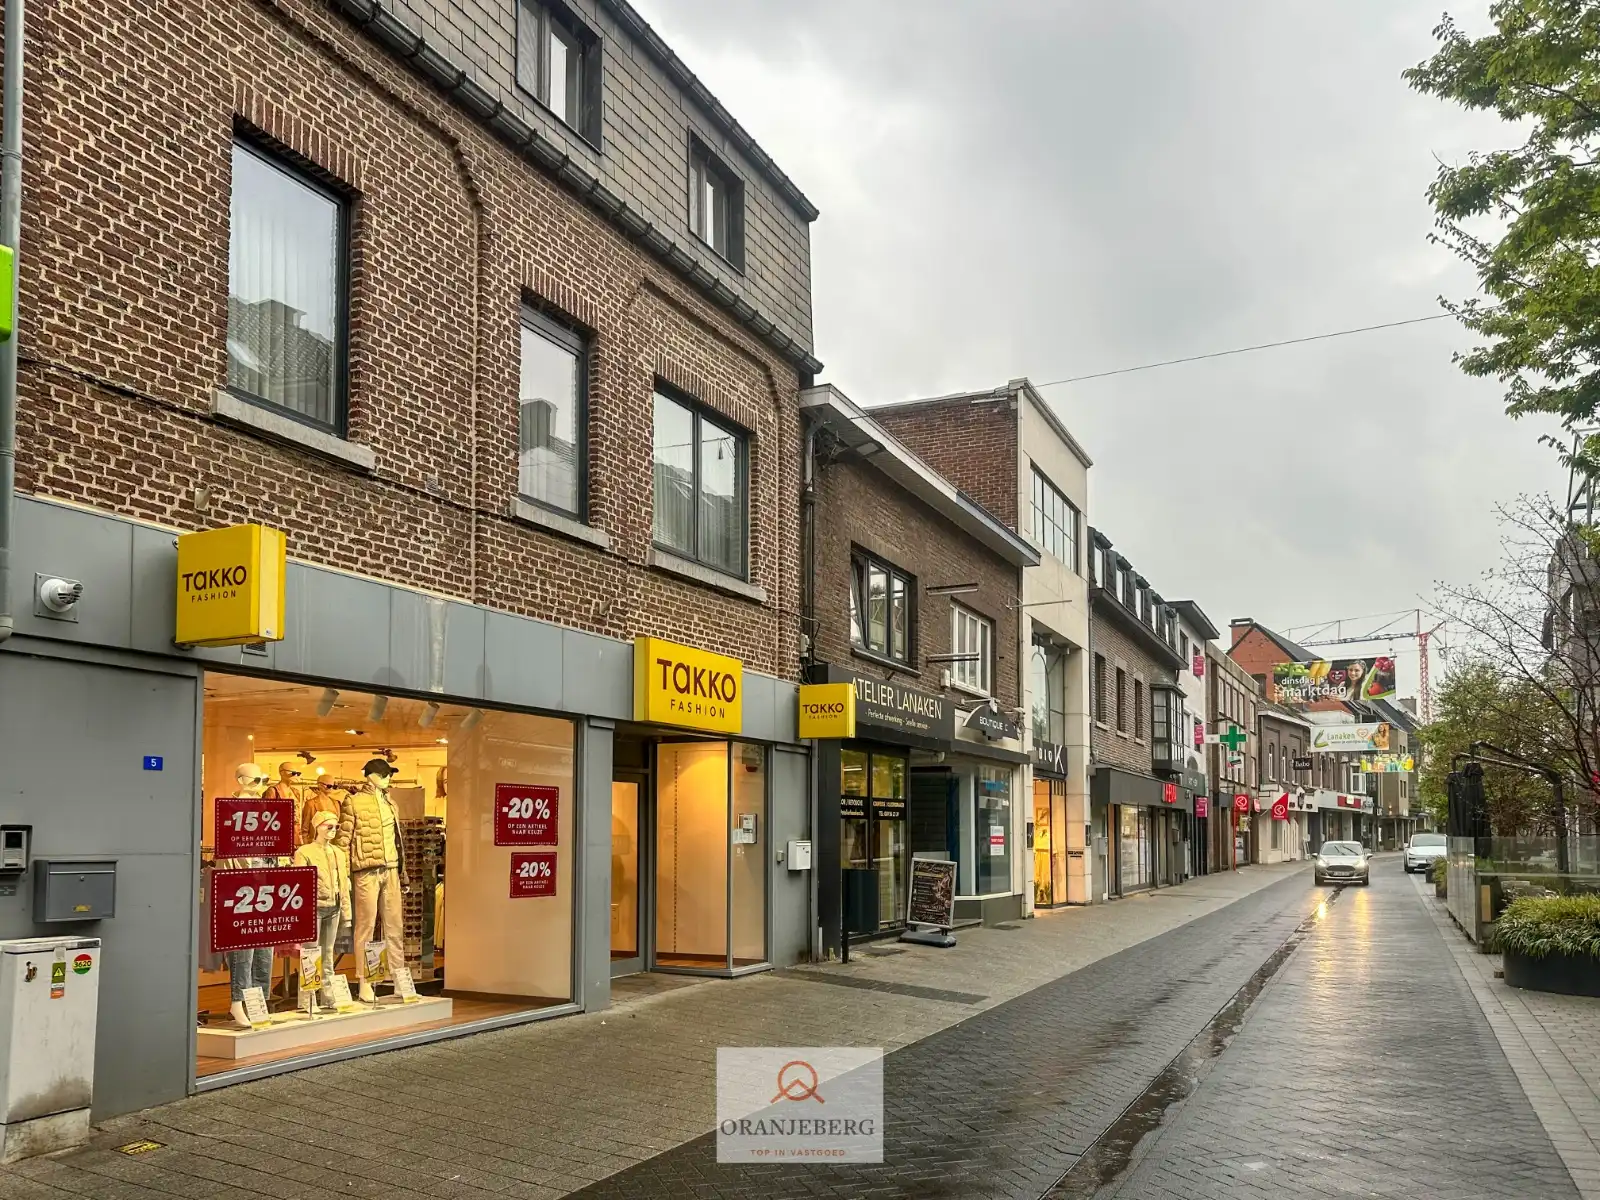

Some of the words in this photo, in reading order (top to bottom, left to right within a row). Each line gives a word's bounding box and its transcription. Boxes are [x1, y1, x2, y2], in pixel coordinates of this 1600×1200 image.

[191, 590, 236, 603] FASHION
[1281, 676, 1315, 686] dinsdag
[852, 676, 894, 708] ATELIER
[897, 689, 942, 720] LANAKEN
[1282, 685, 1347, 698] marktdag
[670, 699, 725, 718] FASHION
[979, 716, 1003, 731] BOUTIQUE
[151, 758, 157, 767] 5
[502, 797, 551, 820] -20%
[223, 811, 281, 832] -15%
[515, 861, 551, 878] -20%
[223, 883, 304, 914] -25%
[233, 920, 245, 928] OP
[267, 915, 300, 925] ARTIKEL
[240, 926, 264, 935] NAAR
[267, 924, 292, 933] KEUZE
[74, 960, 92, 968] 3620
